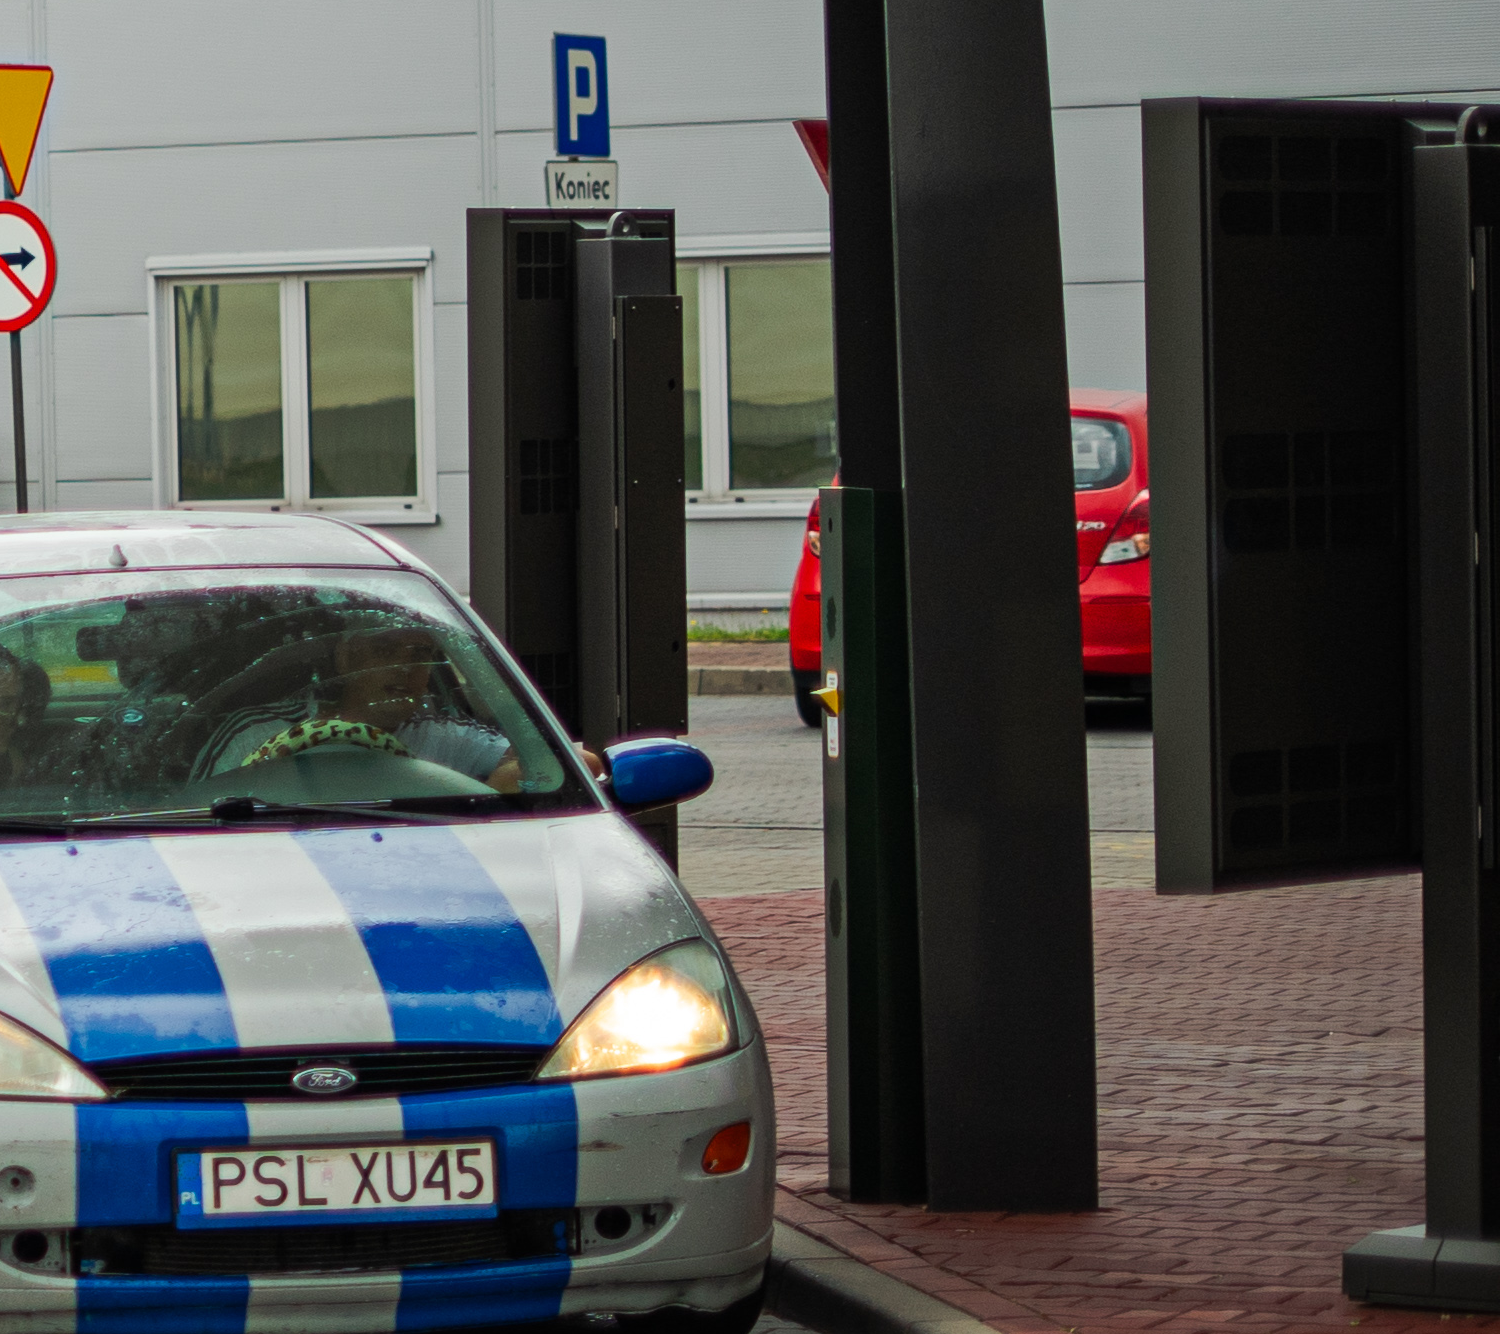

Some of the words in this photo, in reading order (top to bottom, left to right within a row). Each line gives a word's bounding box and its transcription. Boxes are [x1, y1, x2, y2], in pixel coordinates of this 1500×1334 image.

[567, 48, 598, 141] P
[554, 172, 610, 201] Koniec
[308, 1072, 342, 1087] Ford
[211, 1154, 328, 1210] PSL
[350, 1147, 485, 1205] XU45
[180, 1192, 200, 1205] PL
